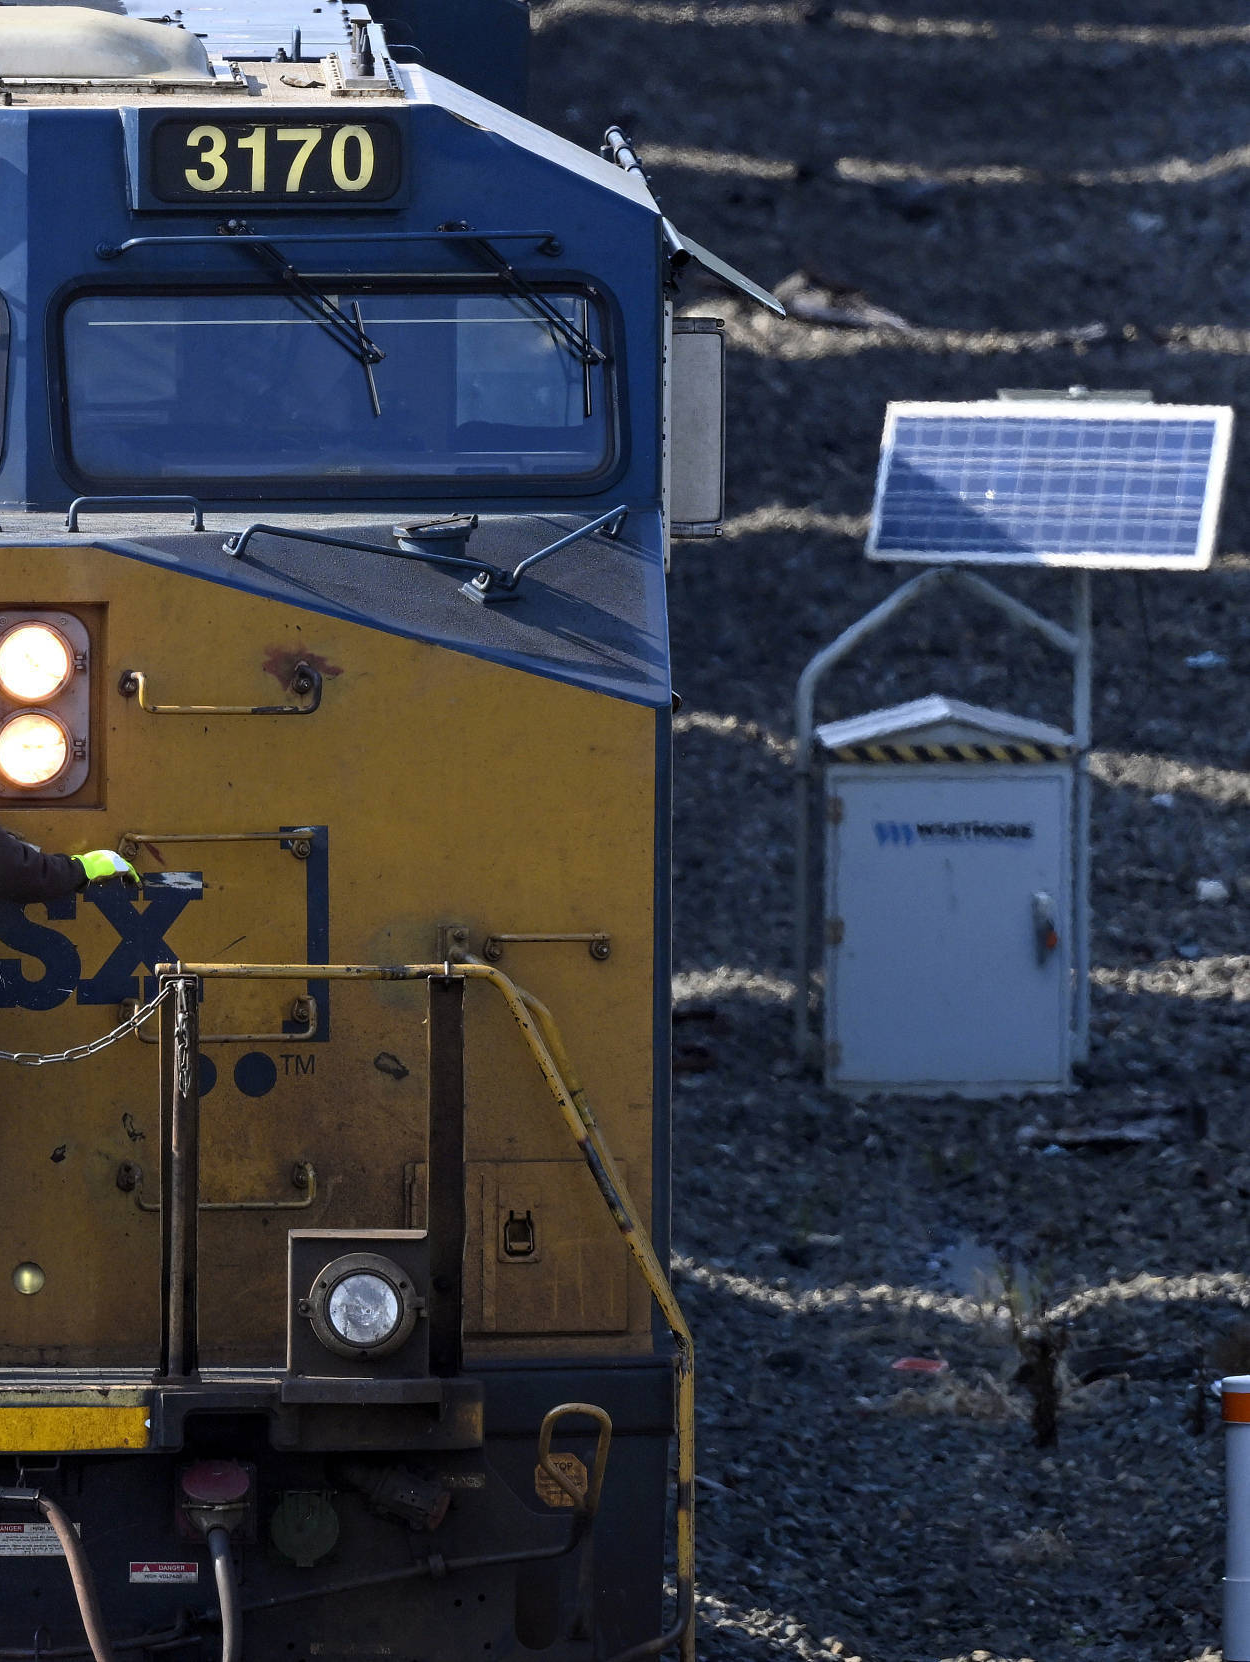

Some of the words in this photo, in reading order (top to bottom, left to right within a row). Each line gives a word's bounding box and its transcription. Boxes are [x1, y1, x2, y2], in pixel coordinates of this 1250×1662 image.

[184, 125, 375, 193] 3170
[280, 1054, 315, 1075] TM
[553, 1462, 573, 1471] TOP
